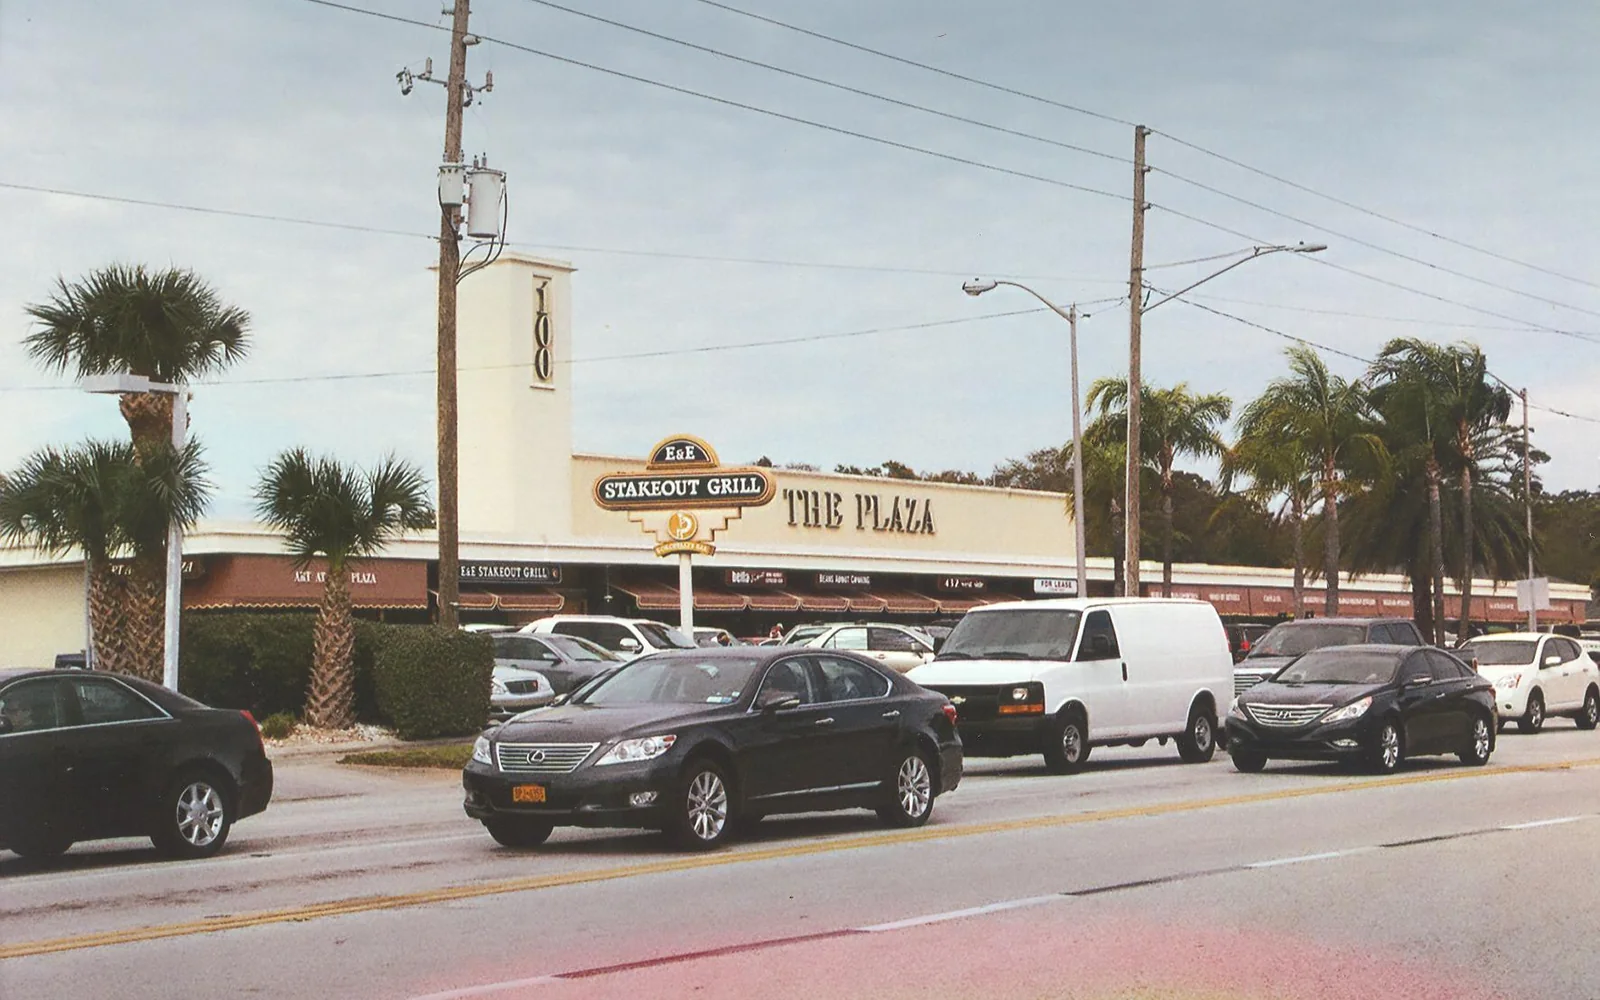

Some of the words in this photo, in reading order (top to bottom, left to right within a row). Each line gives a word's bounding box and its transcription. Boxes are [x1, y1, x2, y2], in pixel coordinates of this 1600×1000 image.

[534, 280, 552, 380] 100
[665, 445, 695, 461] E&E
[604, 479, 700, 499] STAKEOUT
[707, 477, 761, 495] GRILL
[782, 488, 844, 529] THE
[854, 493, 937, 536] PLAZA
[351, 572, 377, 583] PLAZA
[460, 565, 476, 577] E&E
[478, 566, 521, 578] STAKEOUT
[523, 567, 548, 578] GRILL
[1041, 580, 1052, 588] FOR
[1055, 580, 1072, 589] LEASE
